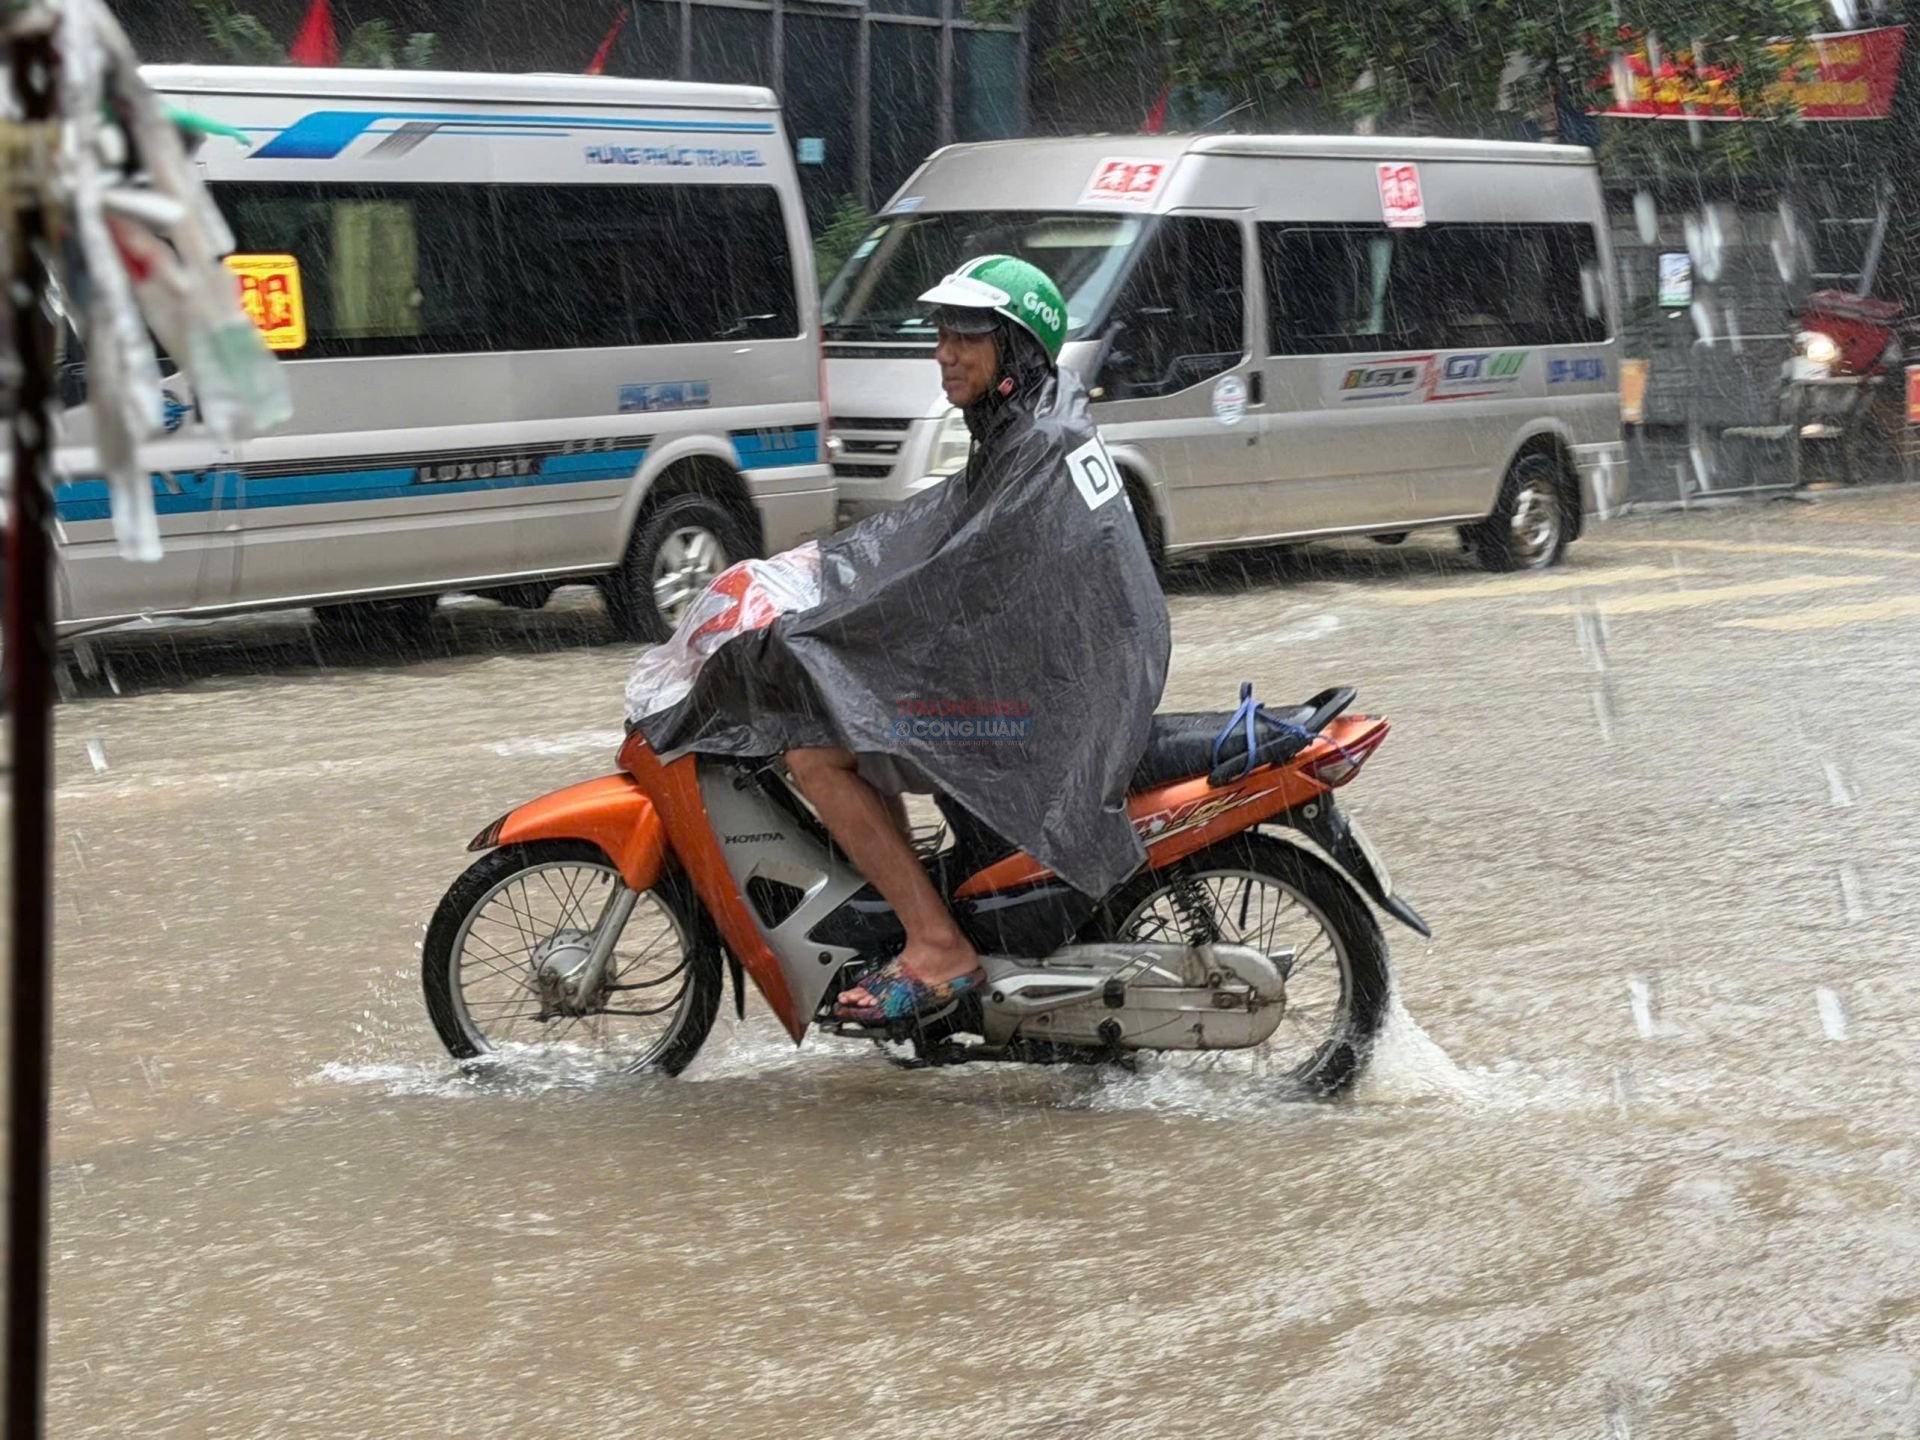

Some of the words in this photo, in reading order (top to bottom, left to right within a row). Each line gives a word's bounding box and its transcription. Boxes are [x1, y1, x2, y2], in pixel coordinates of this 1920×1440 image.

[1023, 291, 1060, 331] Grab
[420, 458, 533, 482] LUXURY
[1080, 455, 1109, 495] D
[725, 832, 785, 844] HONDA
